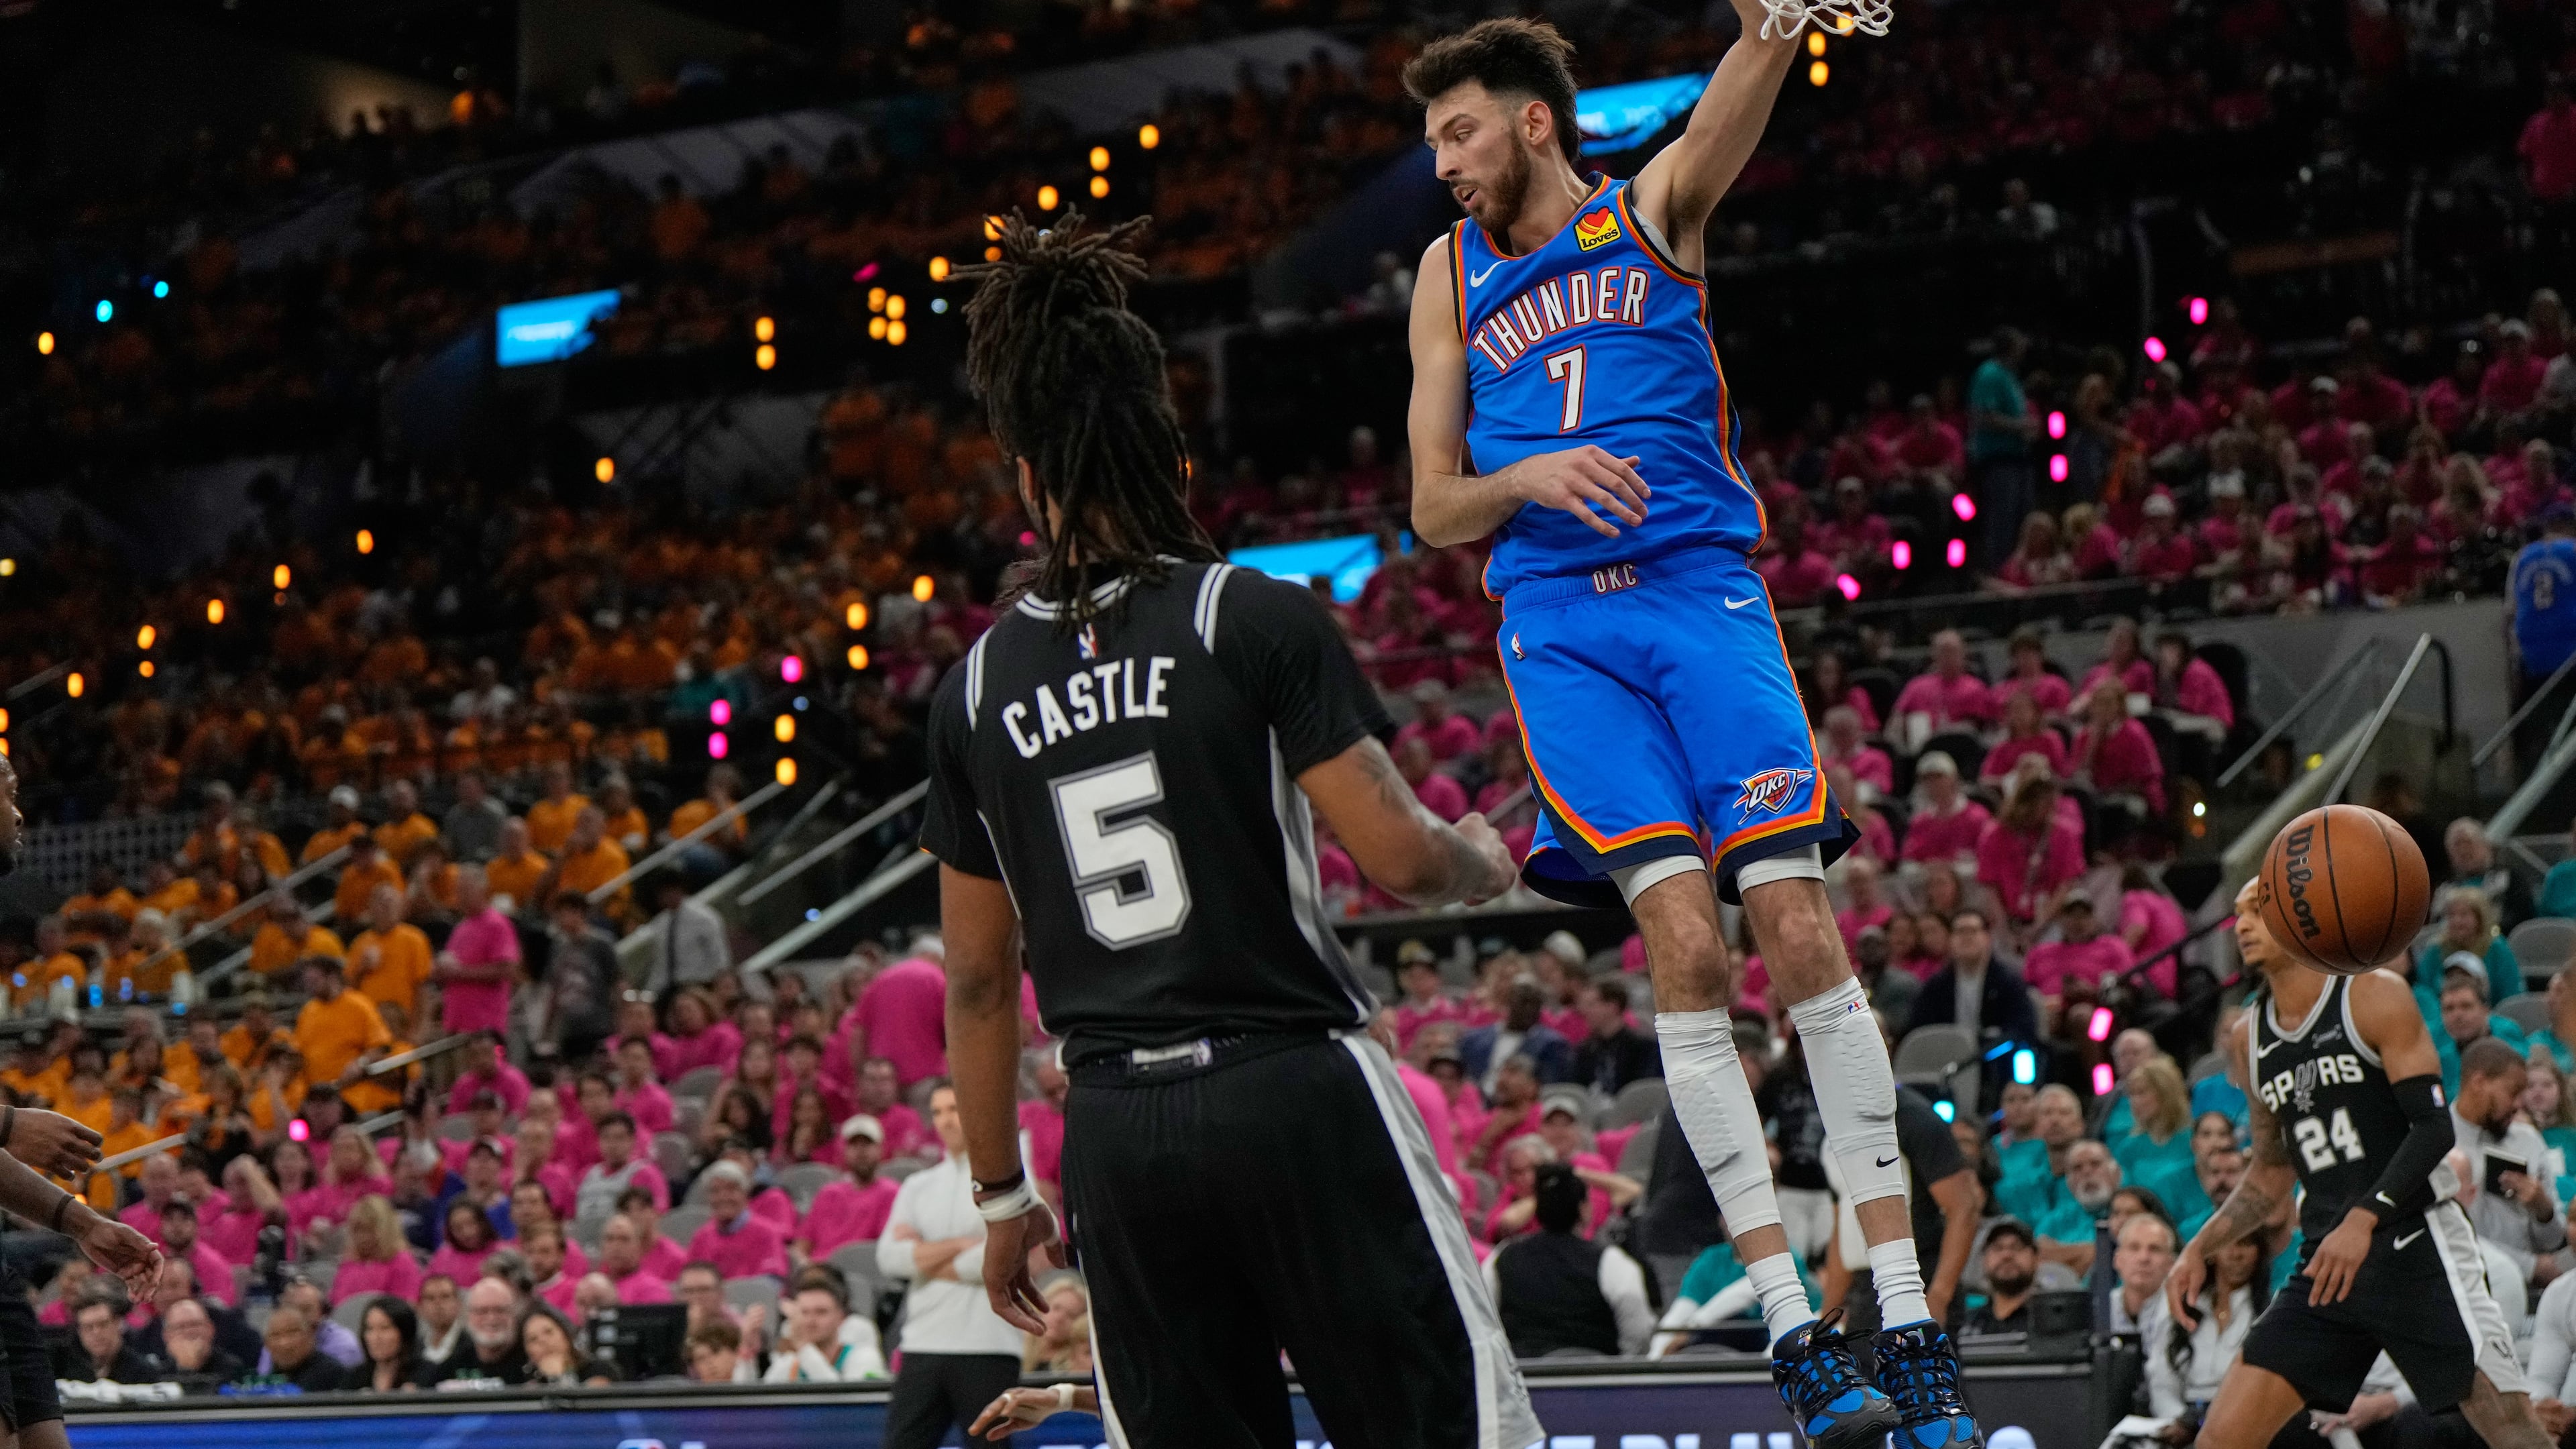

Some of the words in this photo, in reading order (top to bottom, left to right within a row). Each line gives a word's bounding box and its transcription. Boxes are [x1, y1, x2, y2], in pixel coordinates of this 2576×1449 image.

[1471, 268, 1649, 374] THUNDER
[1544, 343, 1587, 433] 7
[1592, 562, 1638, 594] OKC
[1002, 656, 1176, 759] CASTLE
[1748, 772, 1786, 809] OKC
[1046, 749, 1193, 951] 5
[2286, 824, 2321, 941] Wilson
[2293, 1106, 2366, 1173] 24
